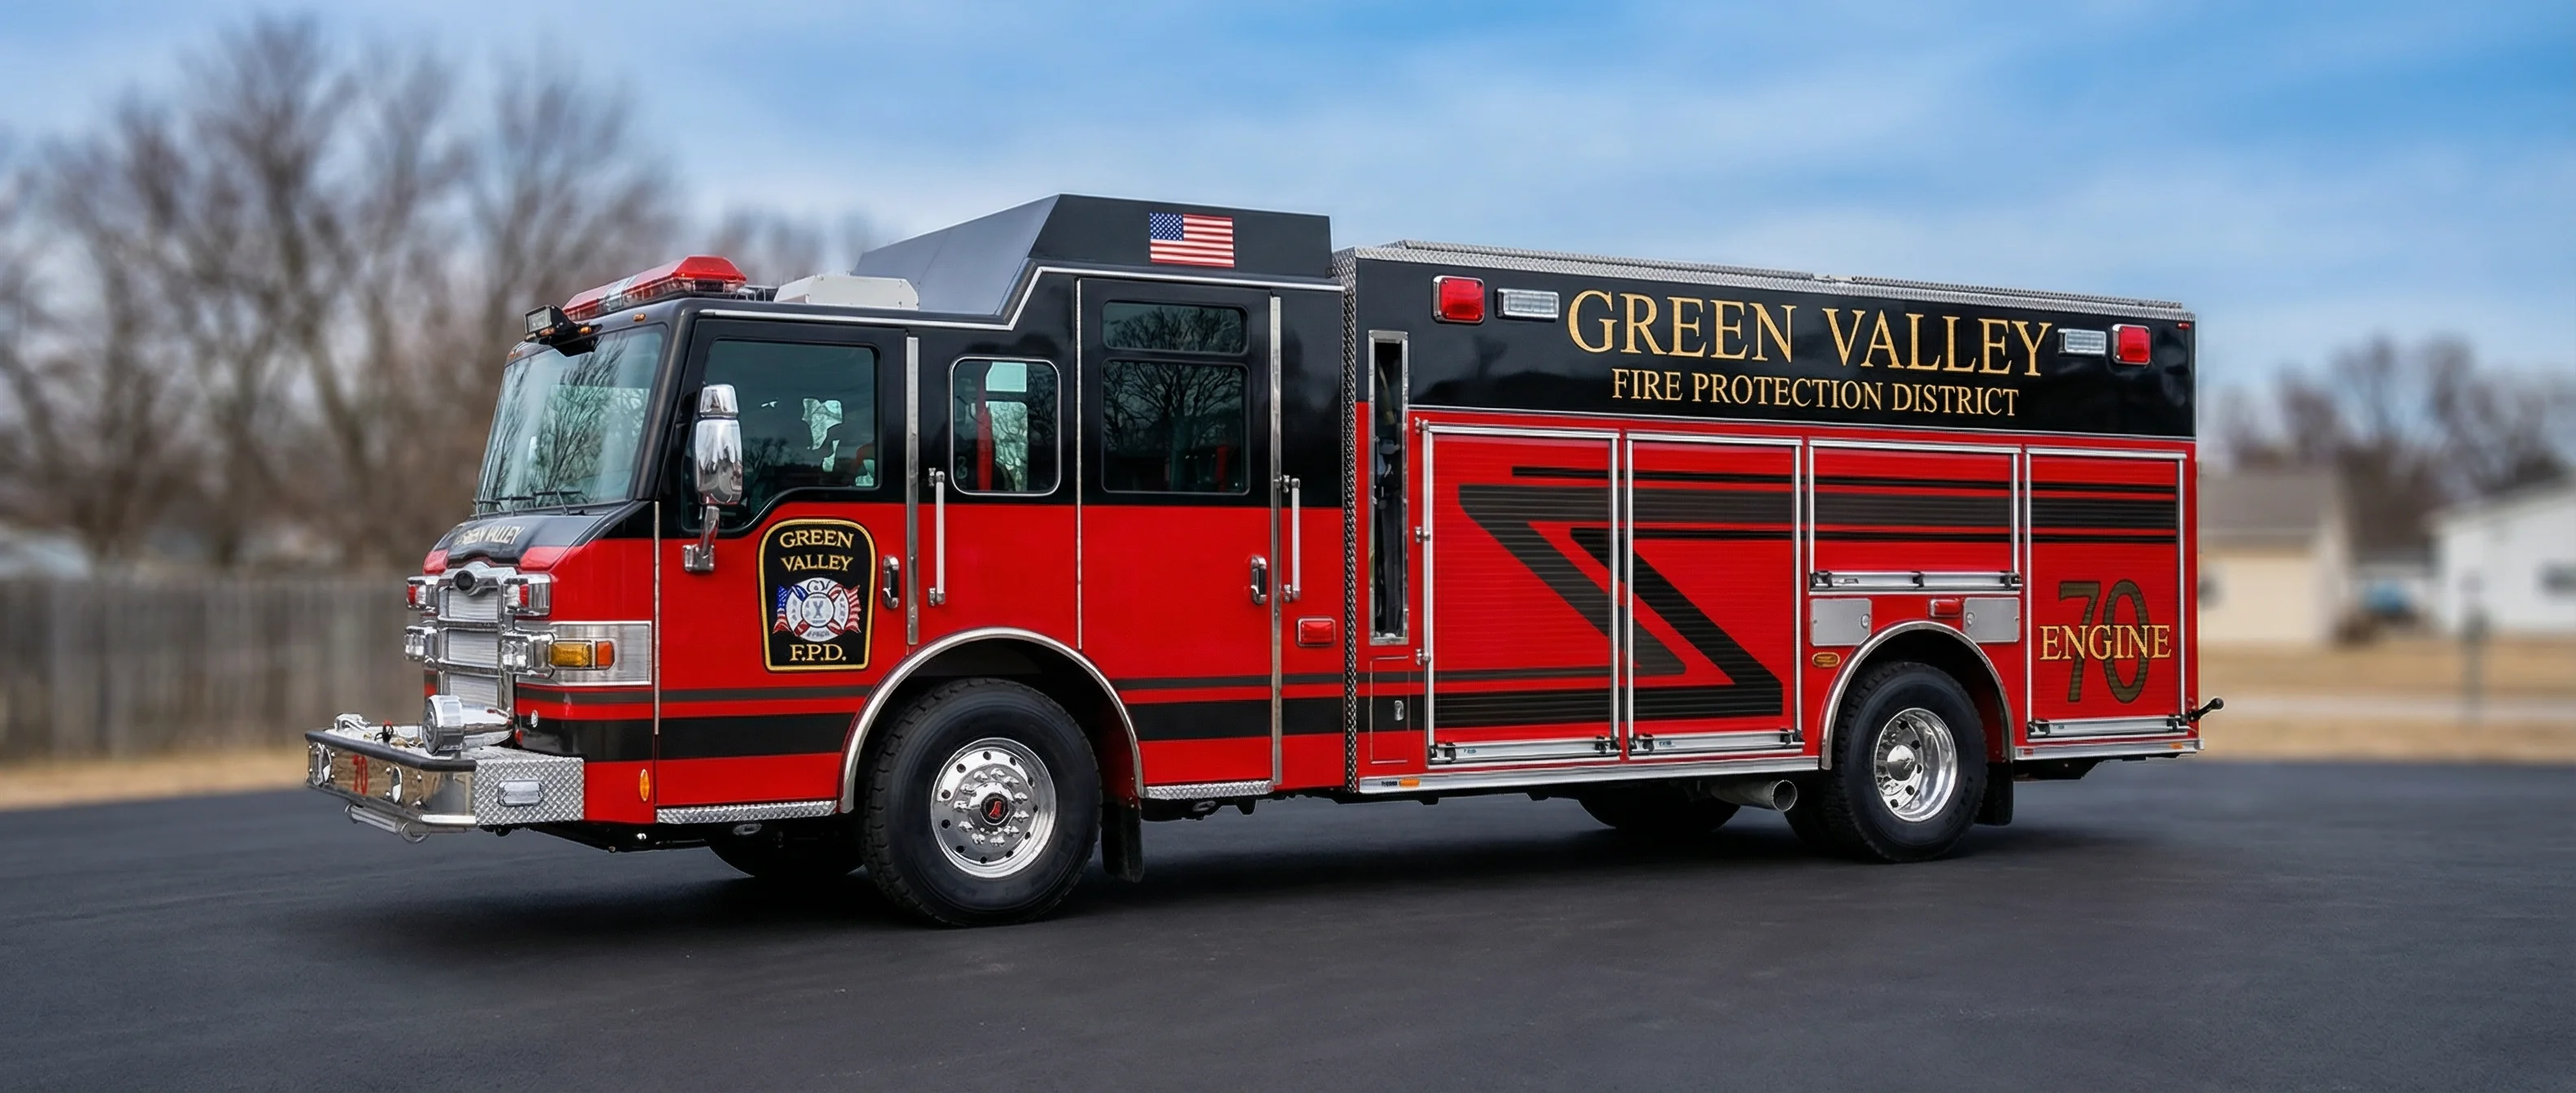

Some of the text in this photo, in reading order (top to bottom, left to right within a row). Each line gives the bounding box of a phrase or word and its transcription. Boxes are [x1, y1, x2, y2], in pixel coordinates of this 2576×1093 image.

[1568, 290, 2052, 377] GREEN VALLEY
[1612, 368, 2019, 416] FIRE PROTECTION DISTRICT
[779, 529, 855, 549] GREEN
[780, 554, 855, 572] VALLEY
[789, 643, 846, 661] F.P.D.
[2039, 625, 2172, 660] ENGINE
[2058, 579, 2150, 704] 70
